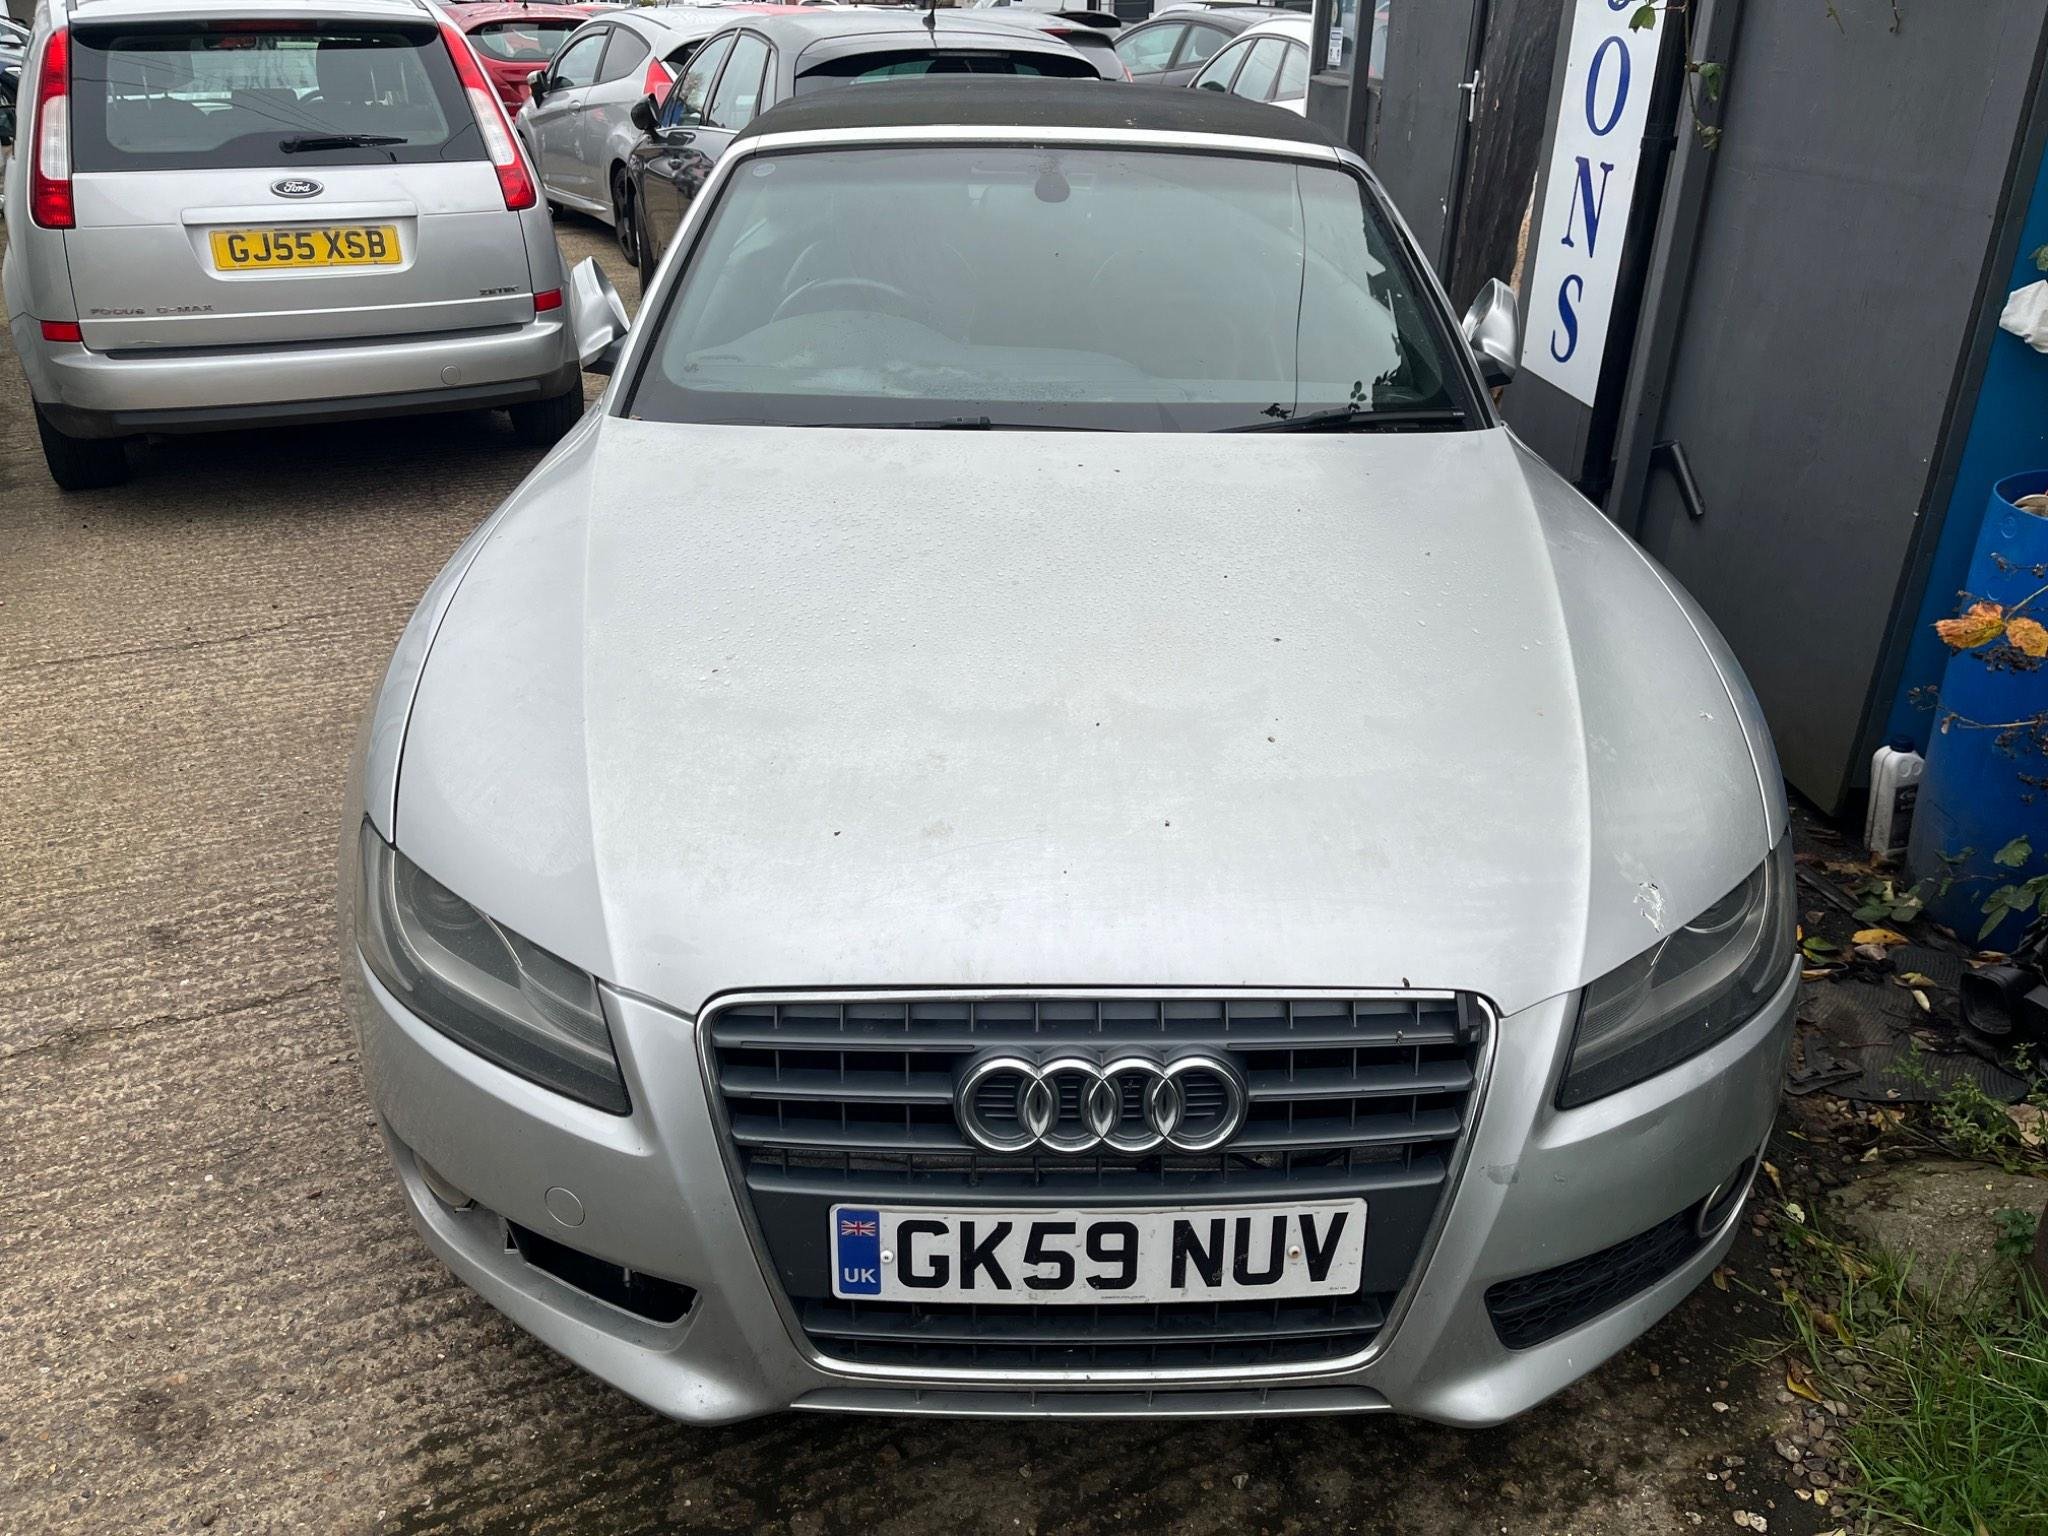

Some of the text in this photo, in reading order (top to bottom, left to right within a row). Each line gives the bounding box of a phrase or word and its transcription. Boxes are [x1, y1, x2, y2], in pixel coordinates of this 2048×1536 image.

[283, 181, 311, 192] Ford
[1550, 0, 1632, 363] ONS
[227, 229, 387, 263] GJ55 XSB
[90, 307, 146, 316] FOCUS
[896, 1212, 1349, 1290] GK59 NUV
[844, 1267, 876, 1283] UK
